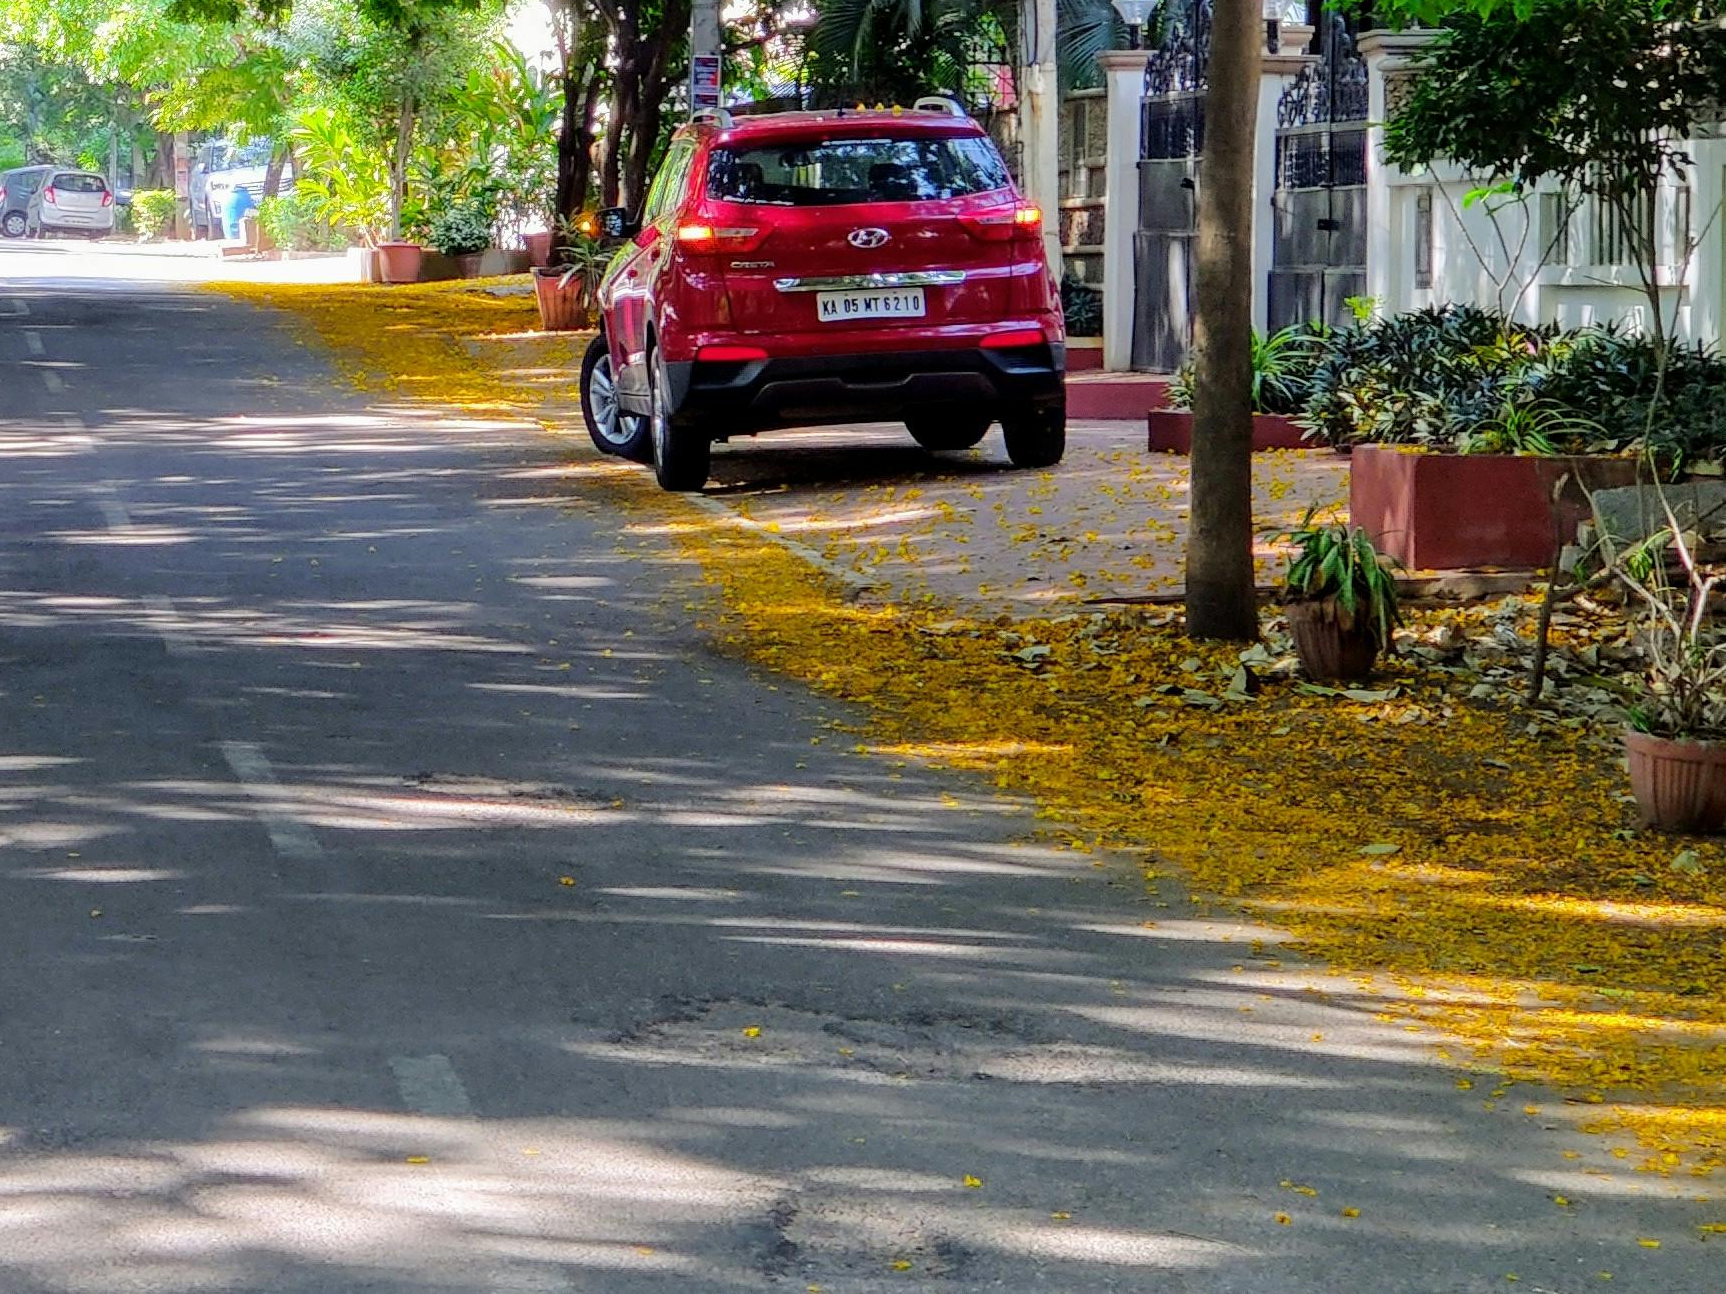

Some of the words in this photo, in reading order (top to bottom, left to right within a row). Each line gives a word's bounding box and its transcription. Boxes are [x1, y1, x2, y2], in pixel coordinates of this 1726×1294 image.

[822, 299, 838, 315] KA
[844, 298, 859, 313] 05
[864, 297, 880, 312] MT
[884, 295, 920, 311] 6210
